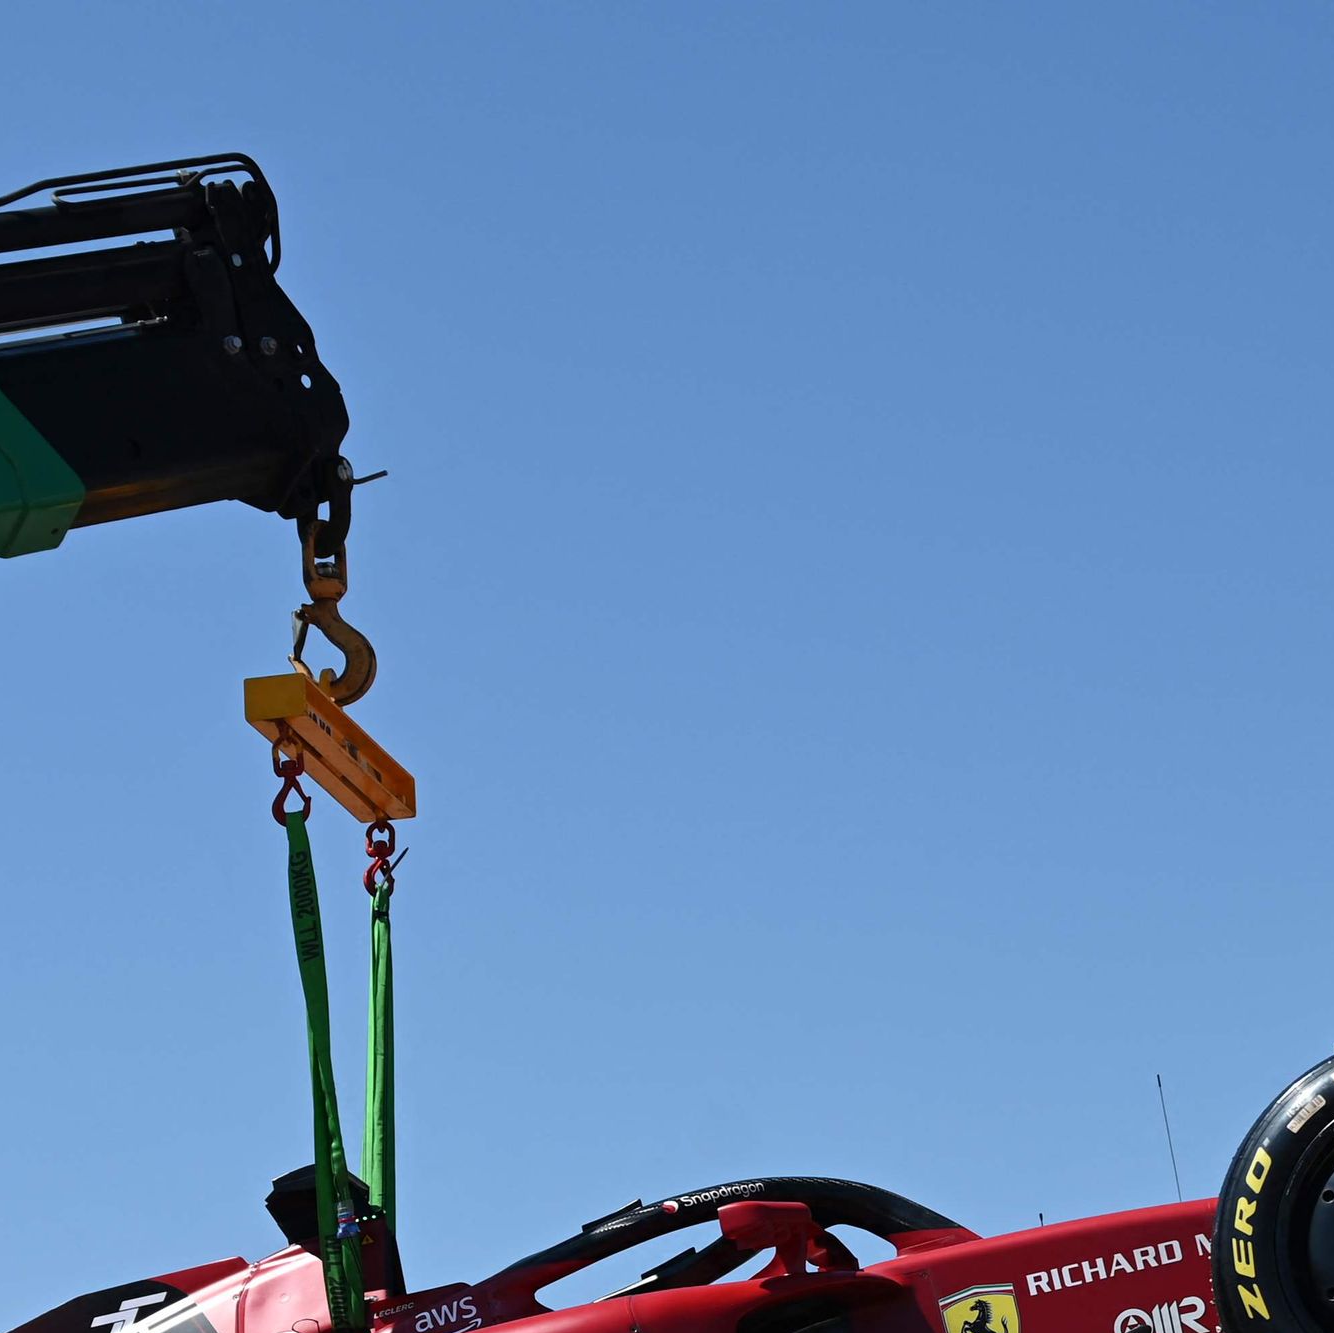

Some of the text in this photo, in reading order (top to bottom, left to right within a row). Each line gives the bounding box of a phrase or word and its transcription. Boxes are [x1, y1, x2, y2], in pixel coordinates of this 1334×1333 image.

[680, 1181, 766, 1207] Snapdragon
[1232, 1146, 1272, 1320] ZERO
[1025, 1239, 1184, 1297] RICHARD
[373, 1301, 416, 1320] LECLERC
[414, 1296, 478, 1333] aws
